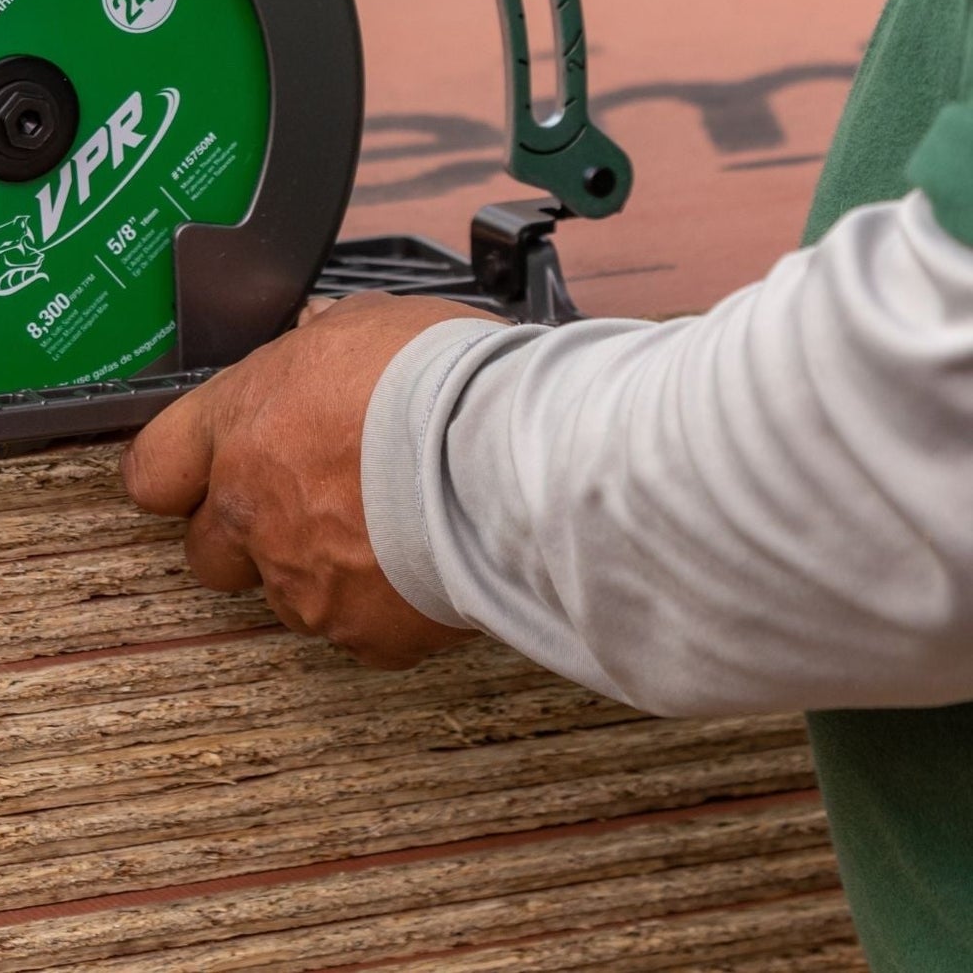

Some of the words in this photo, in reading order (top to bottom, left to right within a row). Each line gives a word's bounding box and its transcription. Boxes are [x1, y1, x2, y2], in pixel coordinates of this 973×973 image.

[35, 91, 147, 243] VPR
[27, 292, 70, 339] 8,300
[120, 353, 133, 366] de
